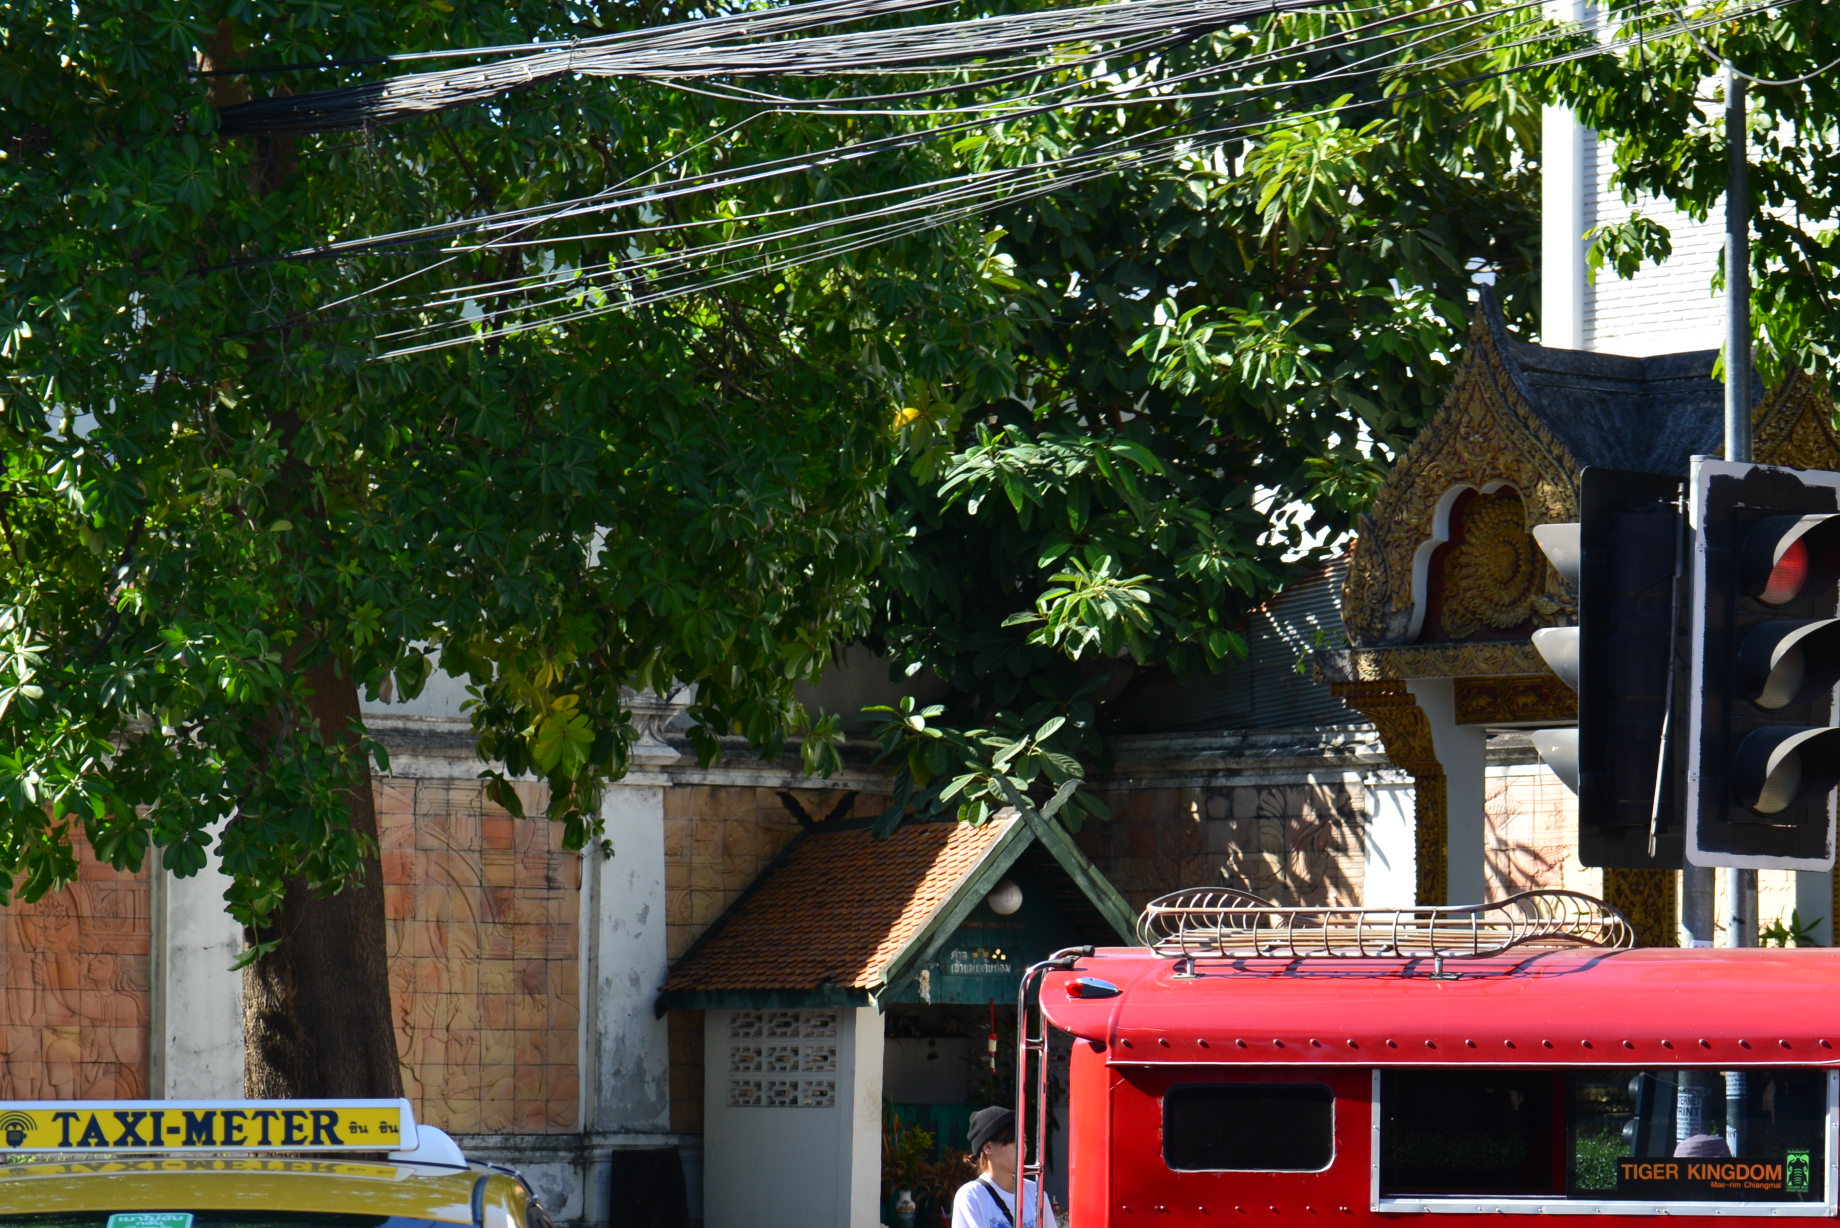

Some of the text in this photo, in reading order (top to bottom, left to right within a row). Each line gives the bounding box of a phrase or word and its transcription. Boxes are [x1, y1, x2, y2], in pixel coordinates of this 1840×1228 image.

[52, 1110, 345, 1147] TAXI-METER
[1621, 1163, 1782, 1181] TIGER KINGDOM
[1710, 1181, 1741, 1189] Mae-rim
[1743, 1181, 1782, 1190] Chiangmai
